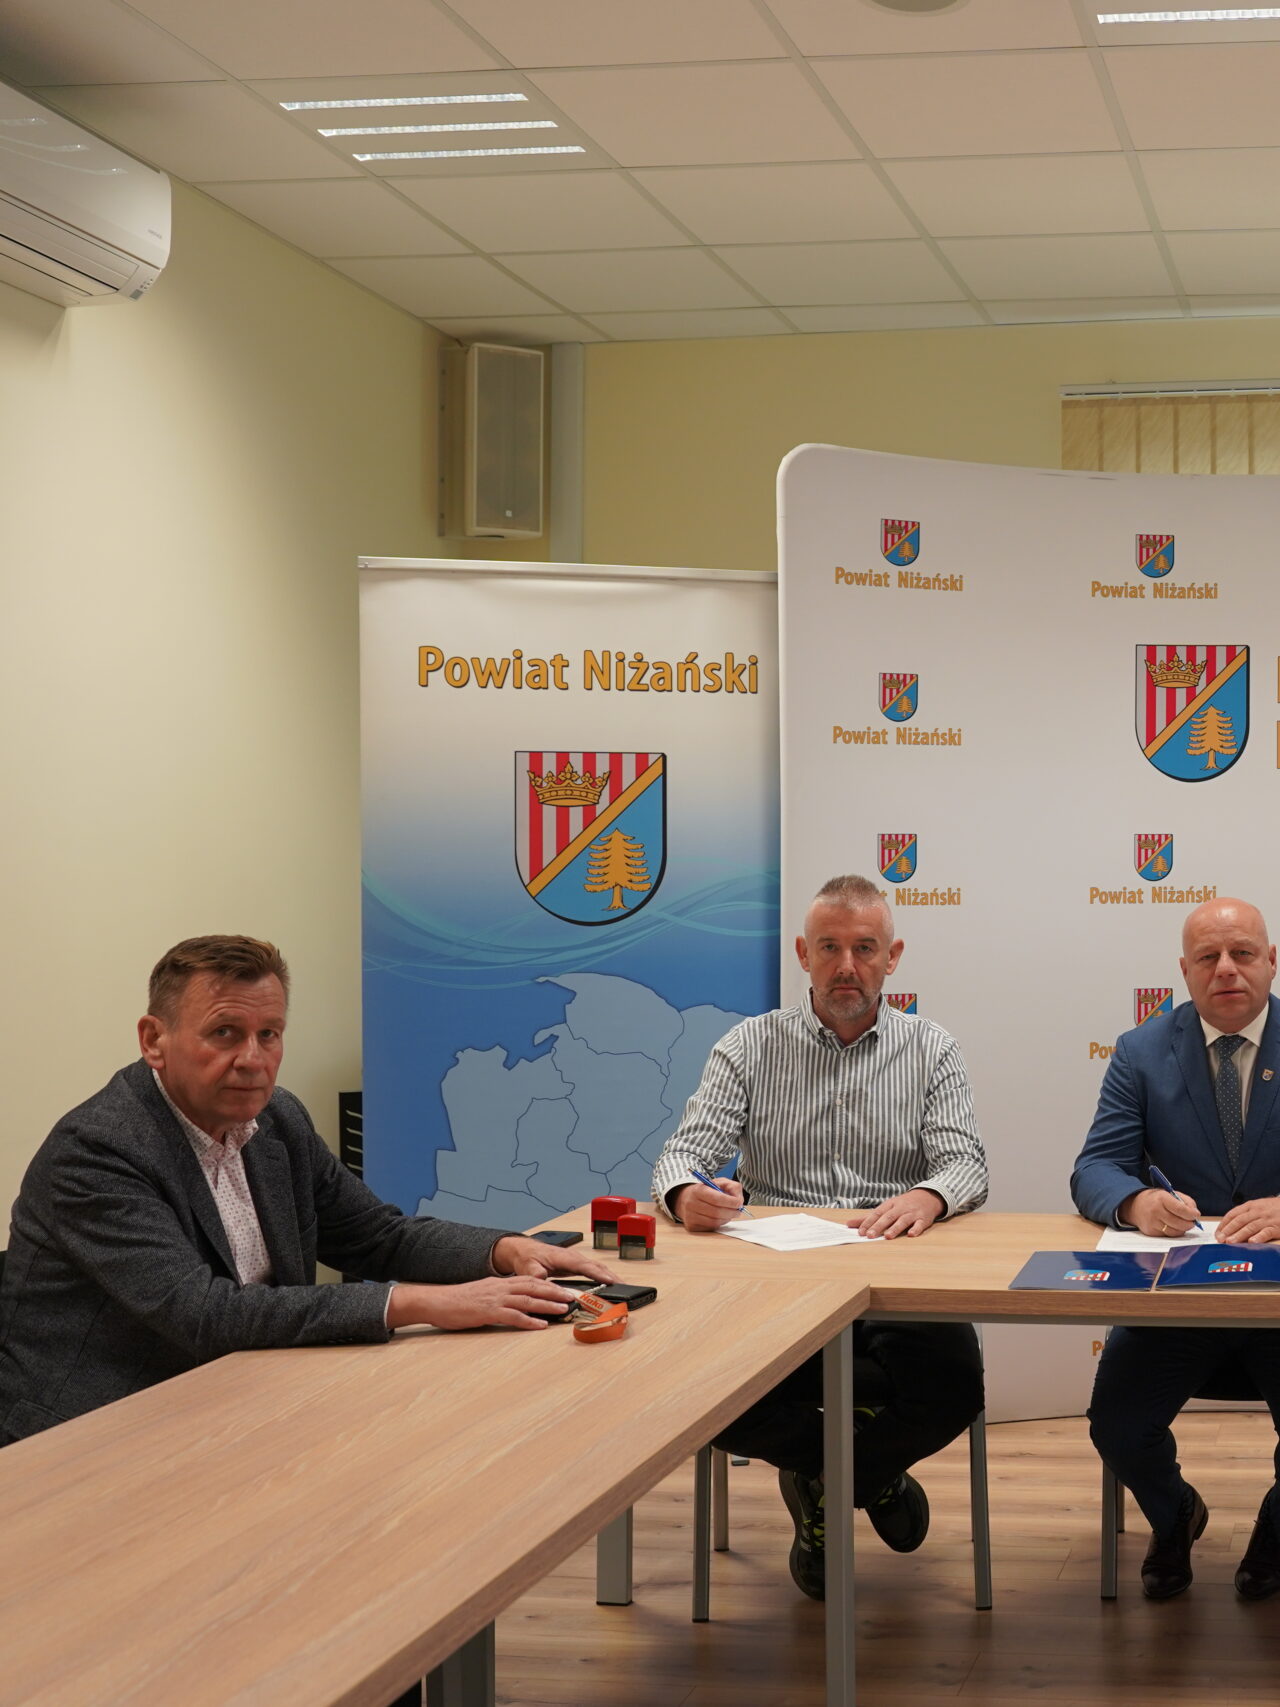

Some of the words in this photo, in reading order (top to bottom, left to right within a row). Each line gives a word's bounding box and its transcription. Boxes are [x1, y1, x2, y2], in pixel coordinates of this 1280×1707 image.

[834, 567, 890, 588] Powiat
[897, 570, 964, 592] Niżański
[1091, 580, 1145, 599] Powiat
[1152, 582, 1218, 600] Niżański
[417, 645, 570, 691] Powiat
[583, 649, 759, 694] Niżański
[832, 726, 888, 745] Powiat
[895, 727, 962, 747] Niżański
[895, 887, 961, 906] Niżański
[1089, 886, 1144, 905] Powiat
[1152, 885, 1217, 903] Niżański
